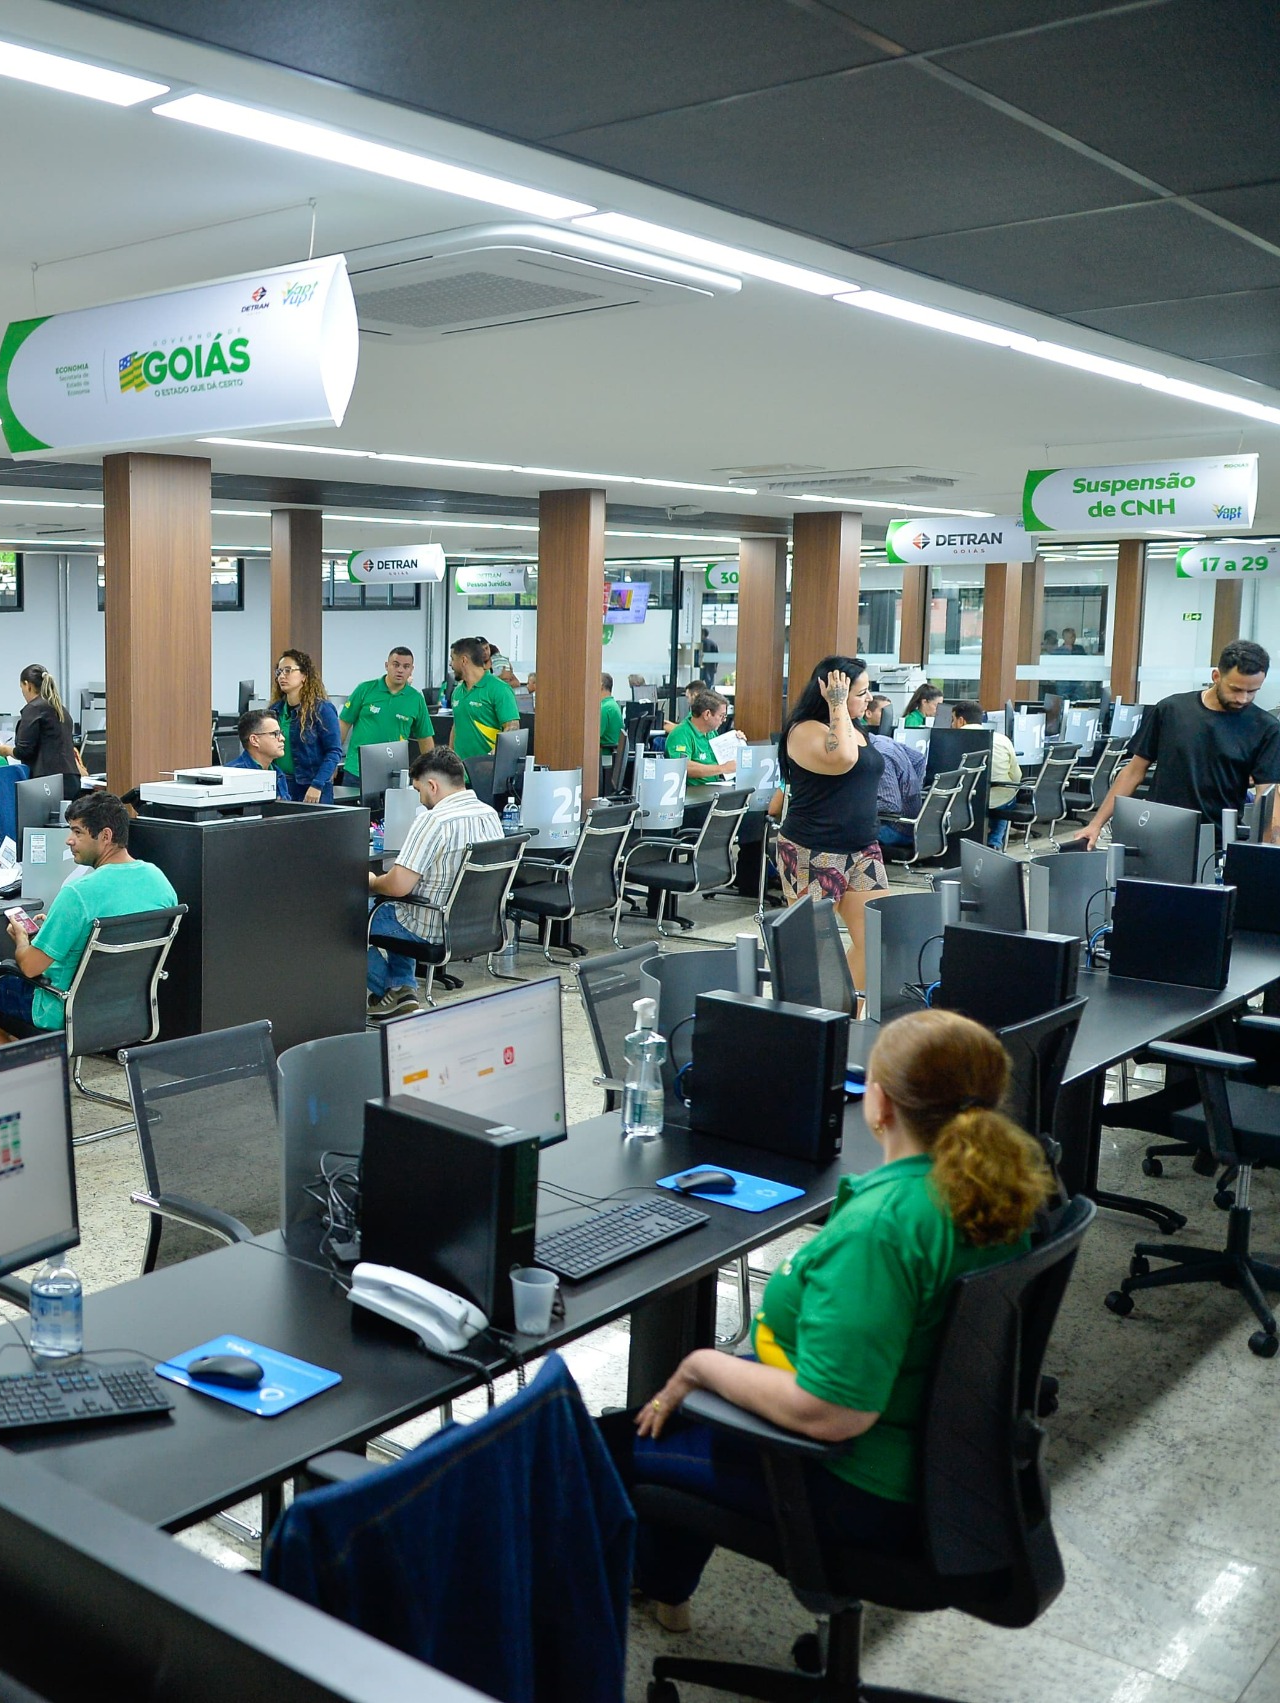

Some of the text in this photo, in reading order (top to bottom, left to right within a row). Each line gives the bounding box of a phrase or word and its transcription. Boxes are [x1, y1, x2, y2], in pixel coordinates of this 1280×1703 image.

[241, 302, 269, 313] DETRAN
[143, 333, 251, 385] GOIÁS
[56, 363, 89, 374] ECONOMIA
[162, 386, 189, 397] ESTADO
[190, 383, 207, 393] QUE
[207, 381, 216, 390] DÁ
[218, 379, 244, 389] CERTO
[1072, 472, 1196, 497] Suspensão
[1088, 499, 1176, 518] de CNH
[935, 532, 1003, 546] DETRAN
[377, 559, 418, 570] DETRAN
[1200, 555, 1269, 572] 17 a 29
[721, 572, 738, 584] 30
